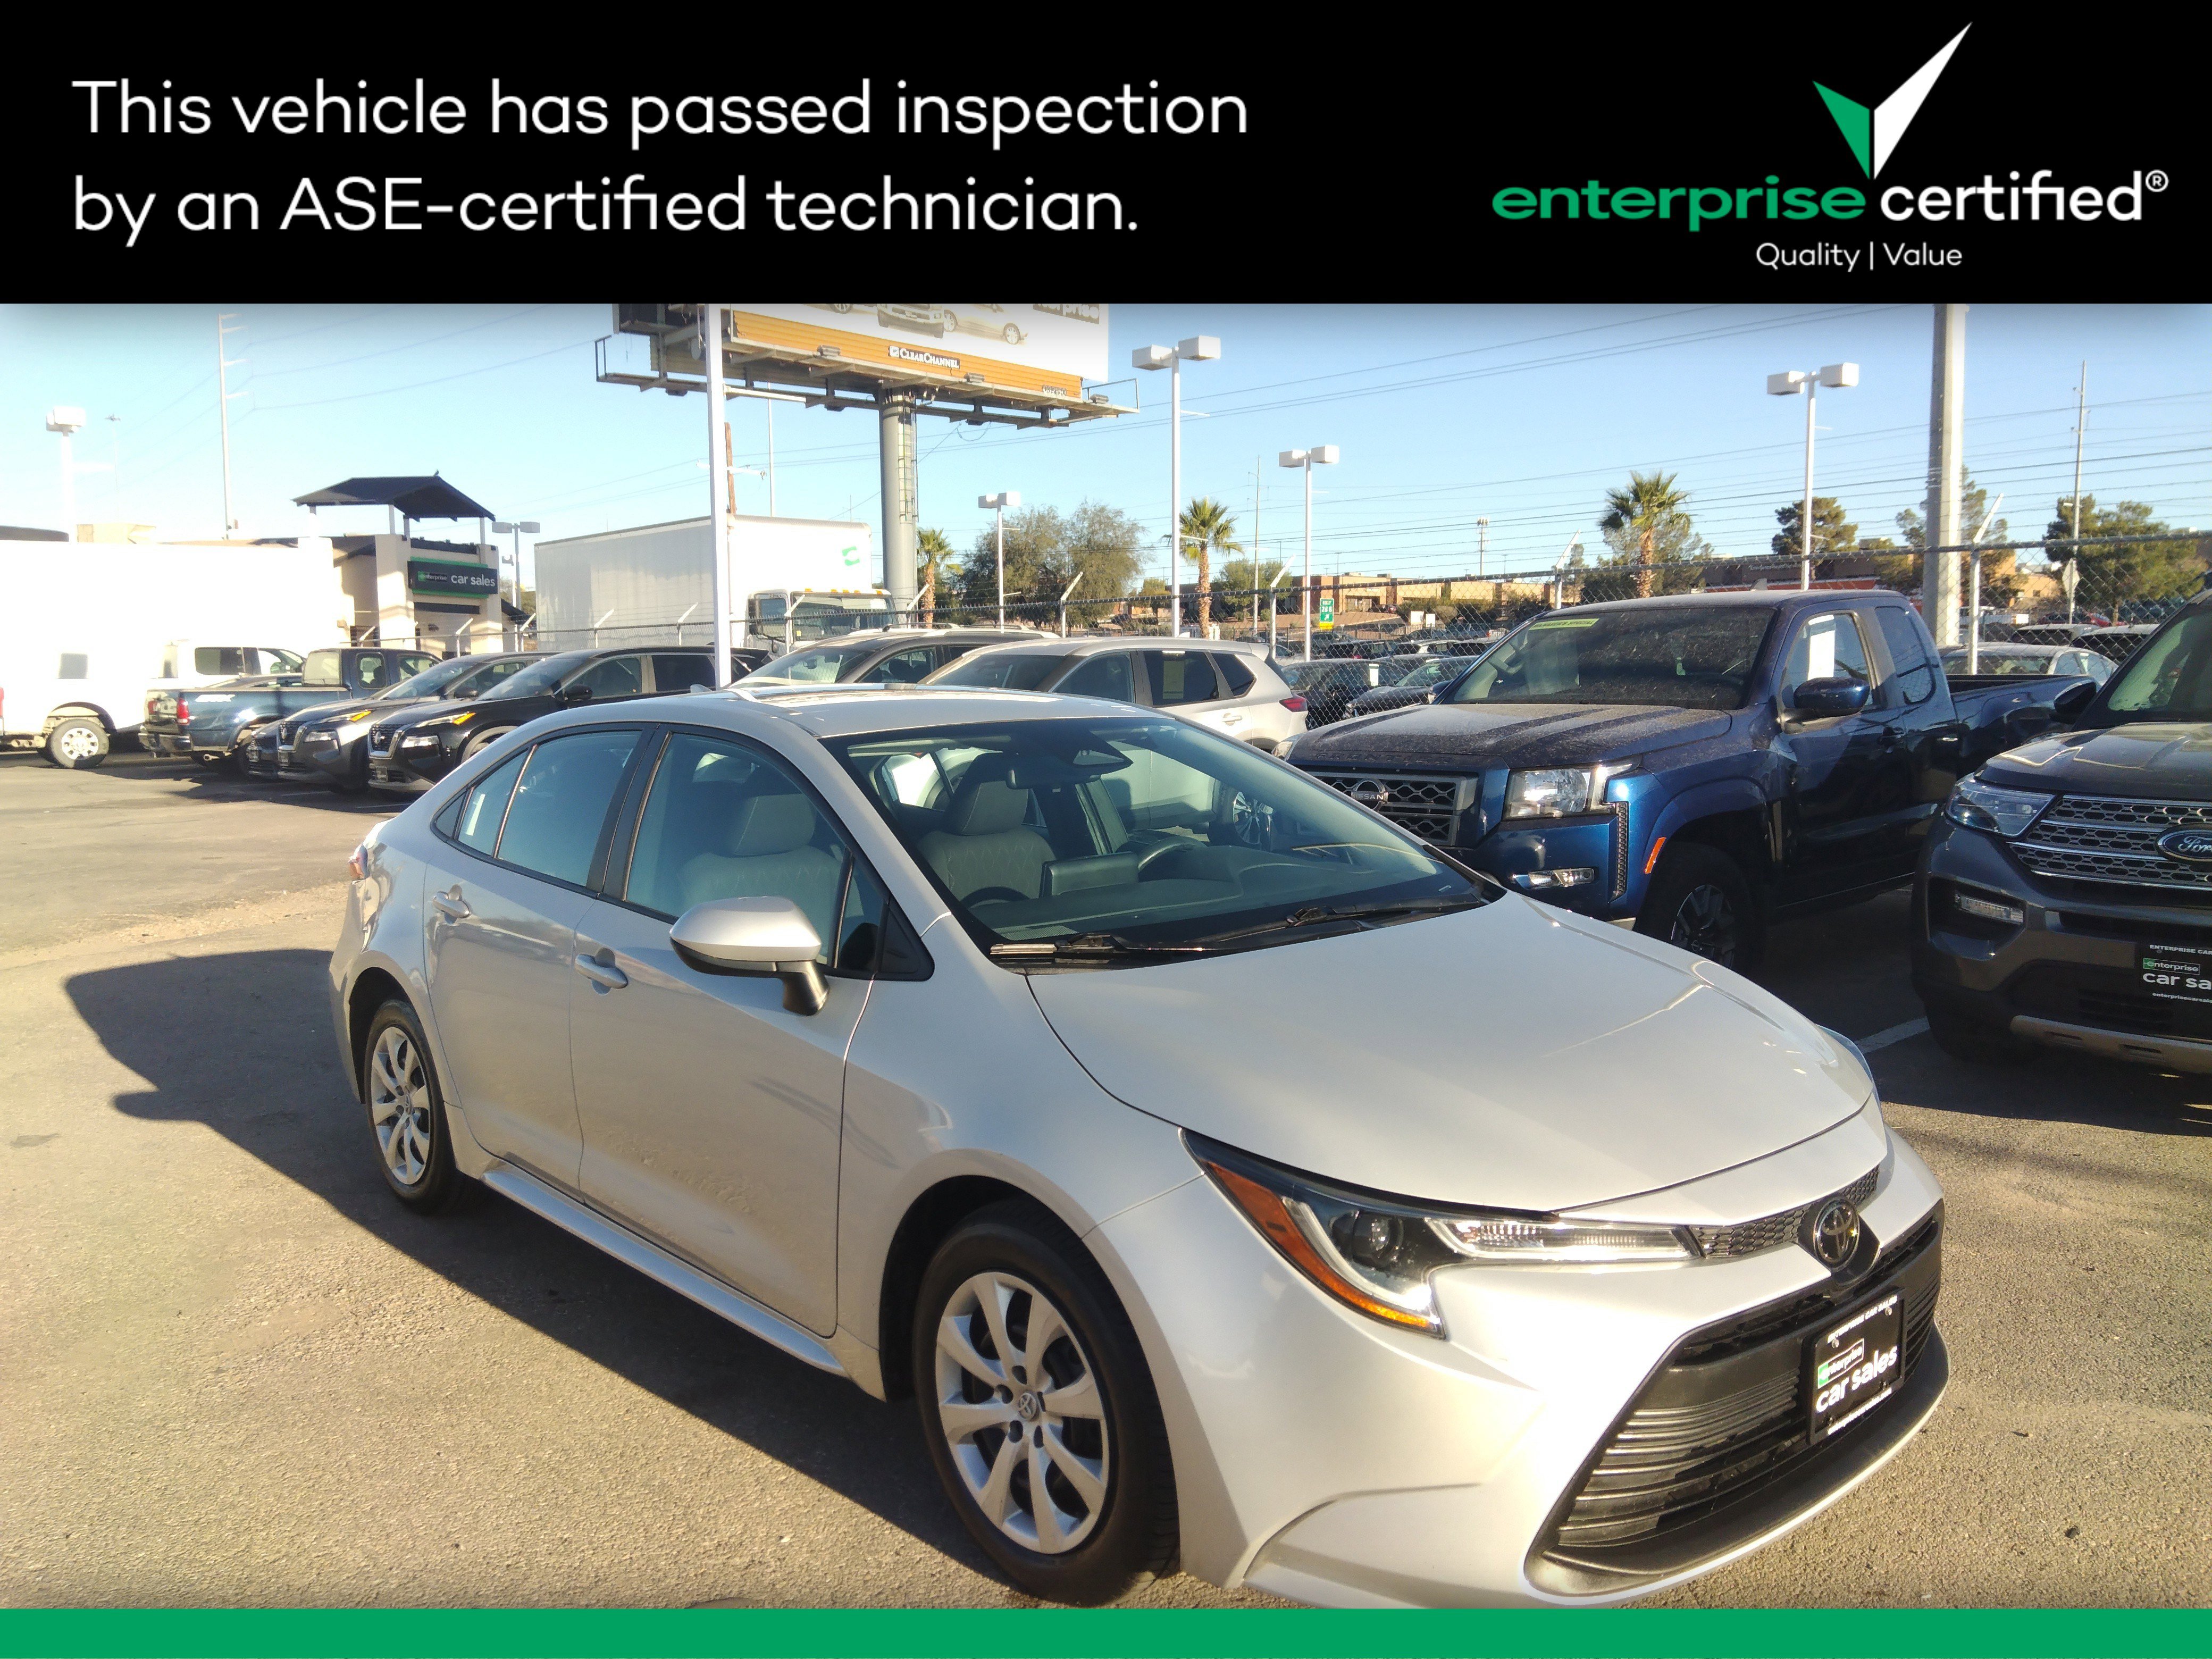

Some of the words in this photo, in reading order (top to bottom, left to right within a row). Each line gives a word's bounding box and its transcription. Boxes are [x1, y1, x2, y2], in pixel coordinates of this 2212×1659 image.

[418, 572, 447, 581] enterprise
[451, 575, 468, 584] car
[471, 574, 496, 586] sales
[2177, 835, 2212, 852] For
[2149, 944, 2196, 953] ENTERPRISE
[2147, 961, 2199, 972] enterprise
[2142, 973, 2180, 985] car
[1819, 1346, 1863, 1380] enterprise
[1816, 1377, 1850, 1414] car
[1851, 1345, 1898, 1391] sales
